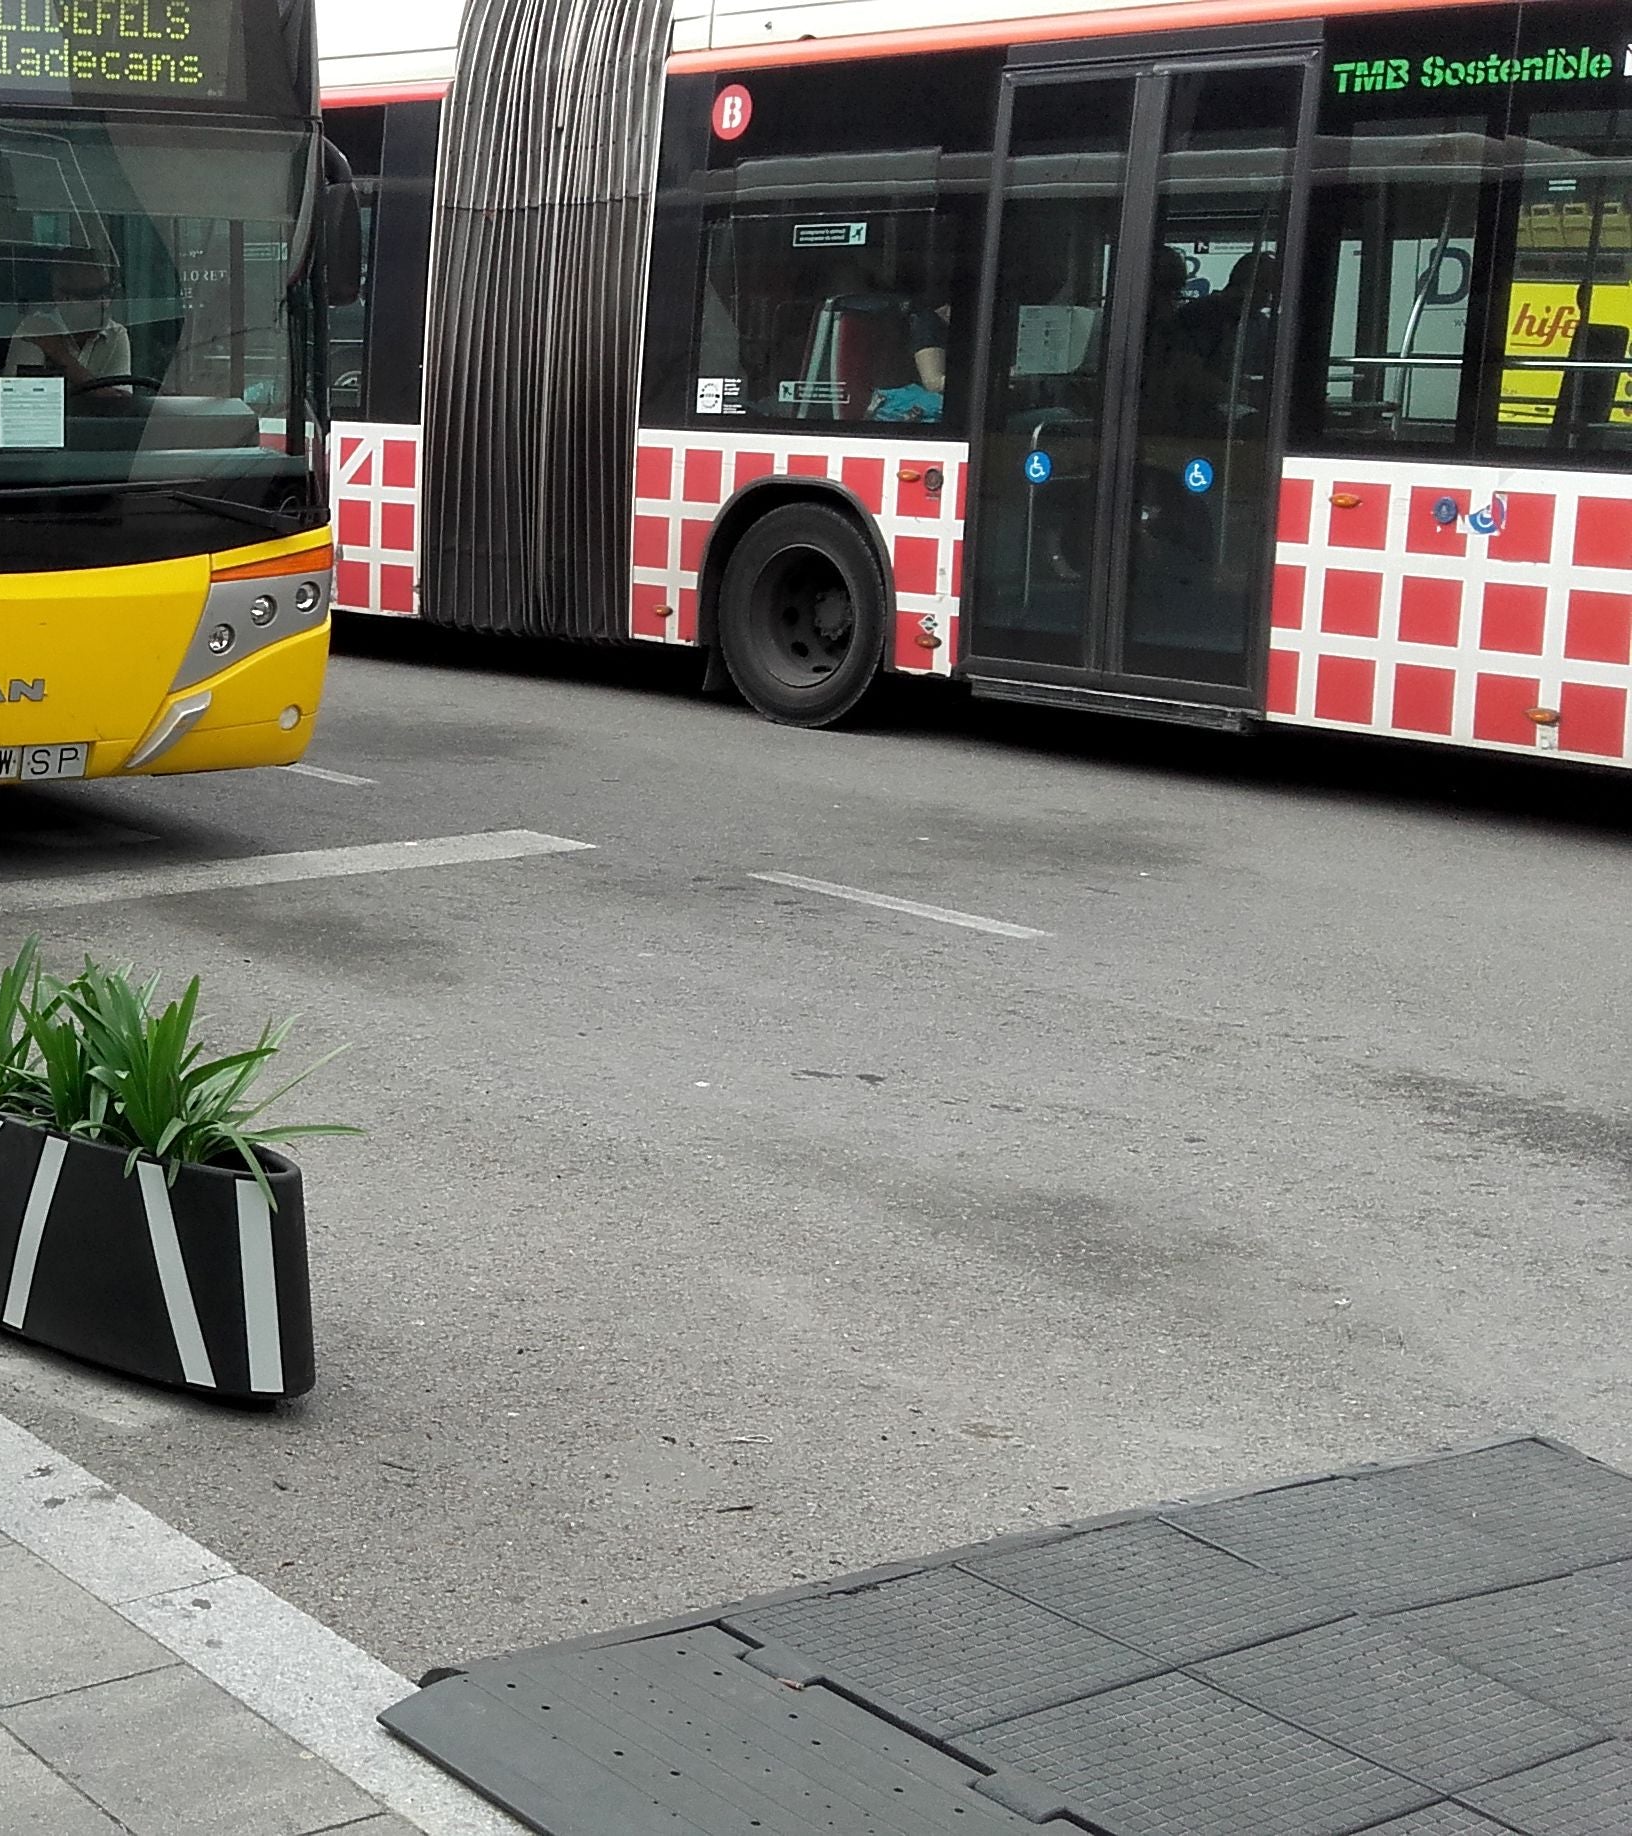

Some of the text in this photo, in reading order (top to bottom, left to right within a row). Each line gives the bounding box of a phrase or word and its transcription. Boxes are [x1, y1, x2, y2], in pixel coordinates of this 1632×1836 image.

[1333, 58, 1410, 93] TMB
[1420, 46, 1613, 88] Sostenible
[721, 96, 743, 130] B
